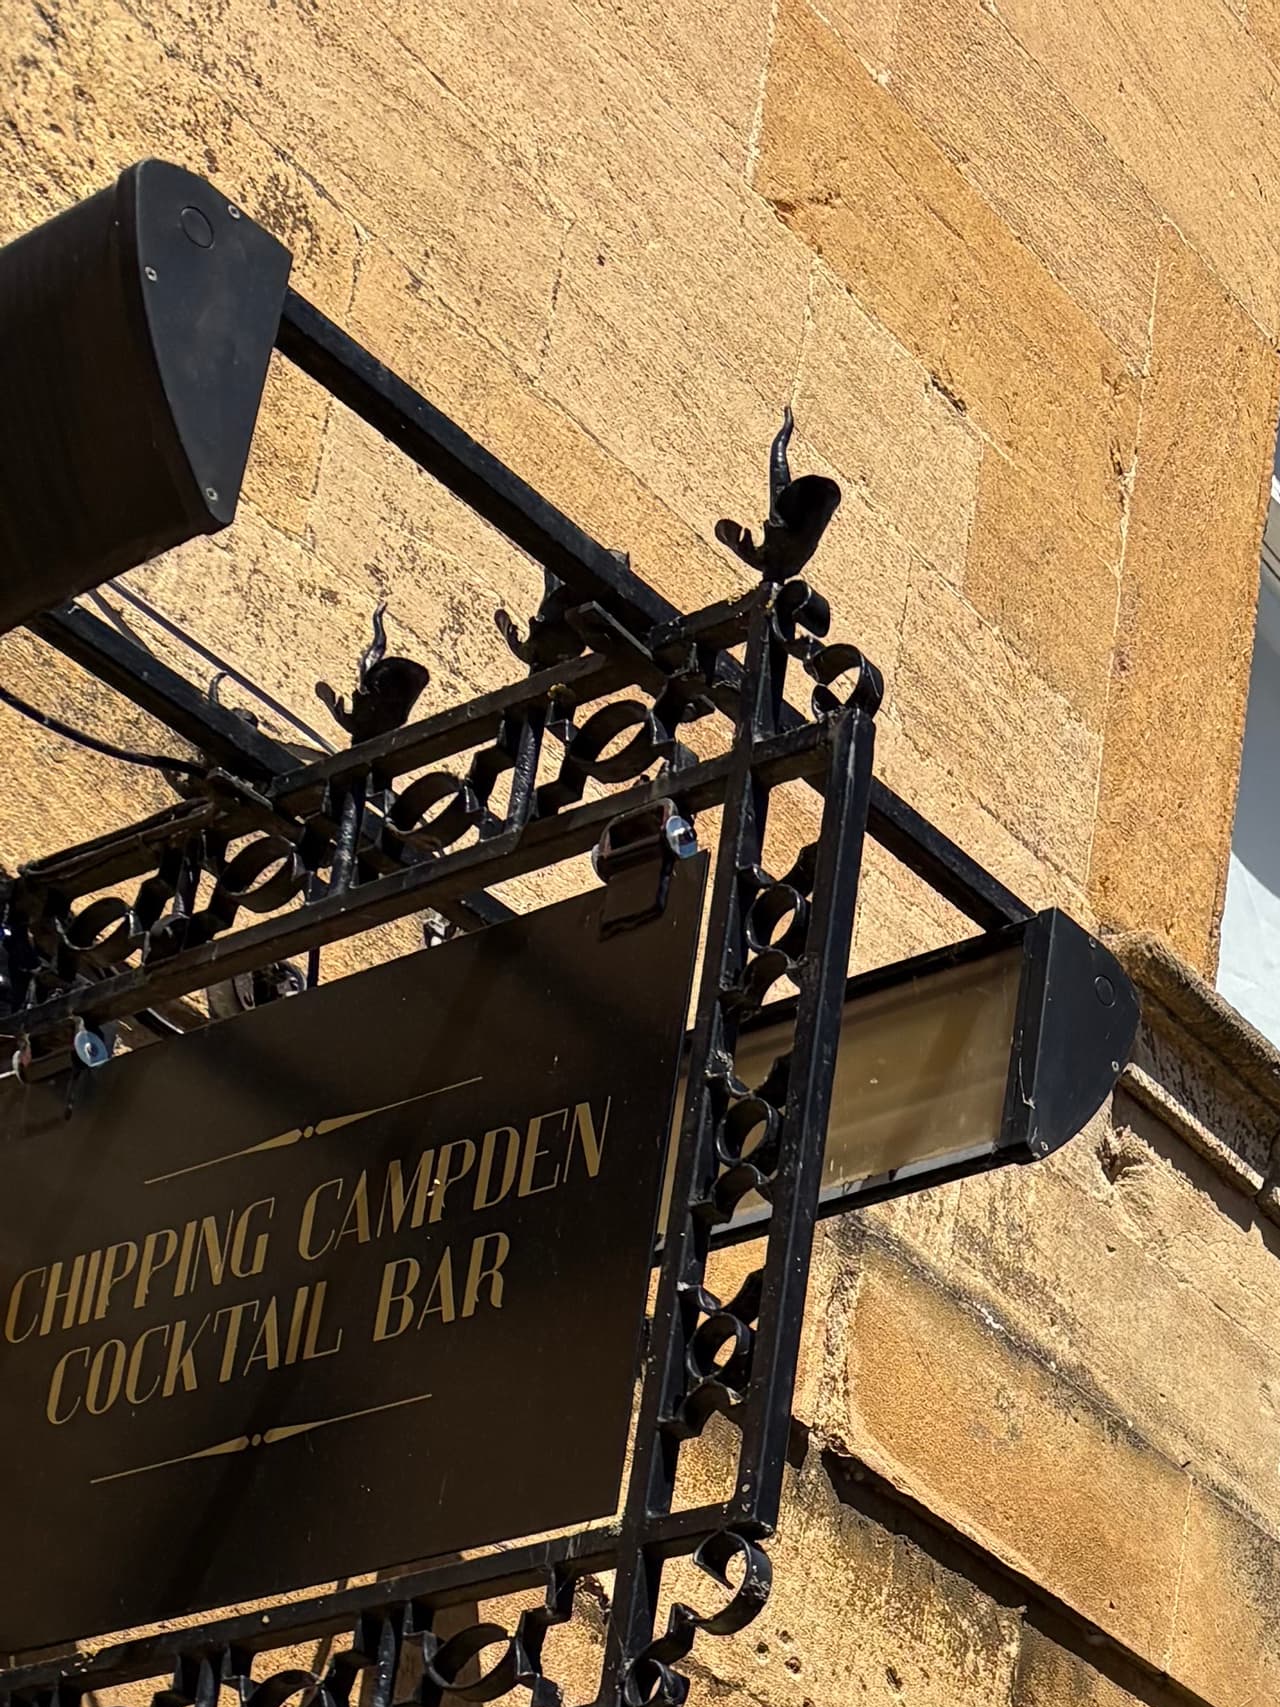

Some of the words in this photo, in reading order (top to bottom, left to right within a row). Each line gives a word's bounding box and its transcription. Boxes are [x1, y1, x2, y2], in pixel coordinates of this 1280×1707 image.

[5, 1197, 275, 1344] CHIPPING
[298, 1096, 611, 1261] CAMPDEN
[46, 1280, 342, 1425] COCKTAIL
[373, 1232, 510, 1342] BAR
